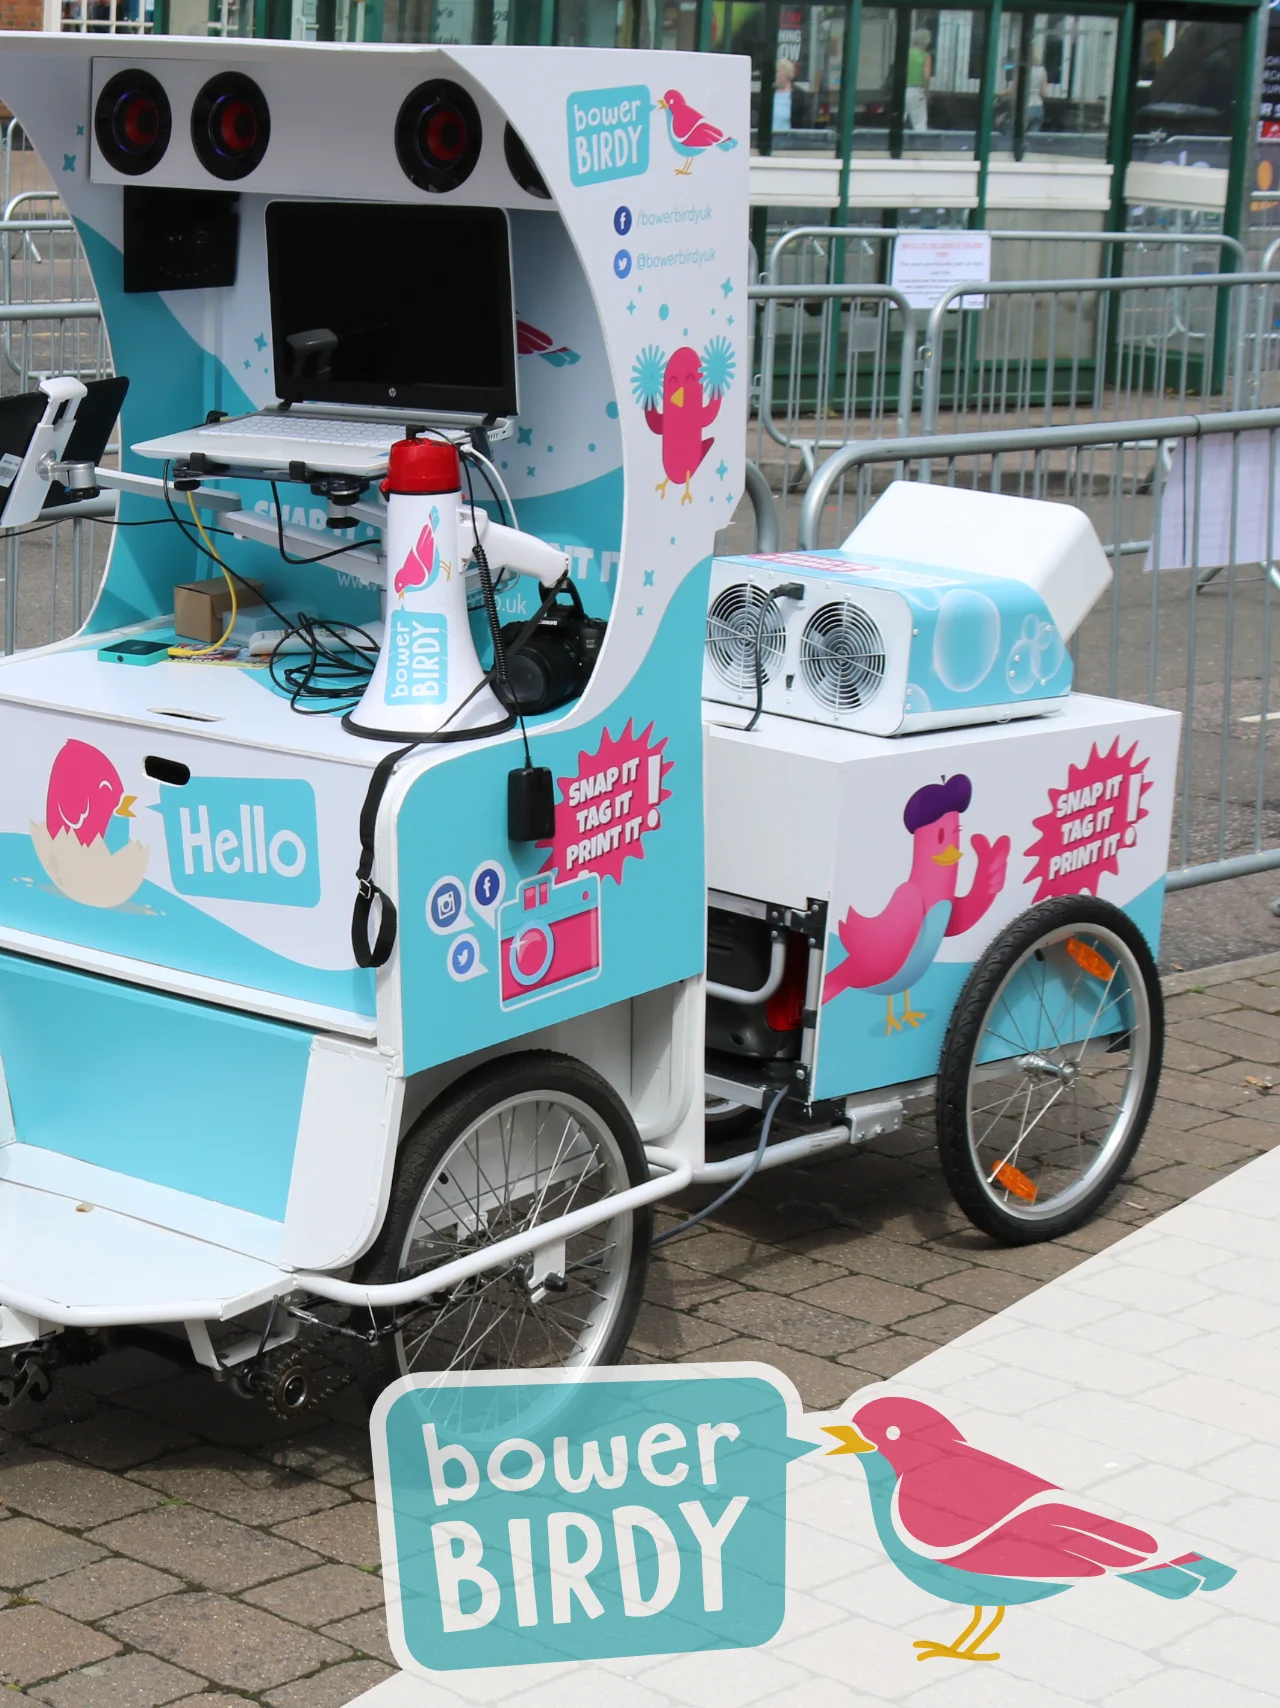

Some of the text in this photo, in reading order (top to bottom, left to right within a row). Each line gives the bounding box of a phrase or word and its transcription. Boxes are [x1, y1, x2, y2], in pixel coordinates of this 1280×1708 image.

[574, 99, 641, 132] bower
[575, 125, 643, 175] BIRDY
[636, 204, 712, 228] /bowerbirdyuk
[636, 247, 716, 270] @bowerbirdyuk
[391, 621, 410, 698] bower
[412, 620, 440, 697] BIRDY
[569, 757, 640, 807] SNAP IT
[1056, 774, 1124, 819] SNAP IT
[576, 790, 633, 834] TAG IT
[1061, 806, 1115, 846] TAG IT
[179, 804, 306, 878] Hello
[566, 816, 642, 871] PRINT IT
[1048, 833, 1121, 881] PRINT IT
